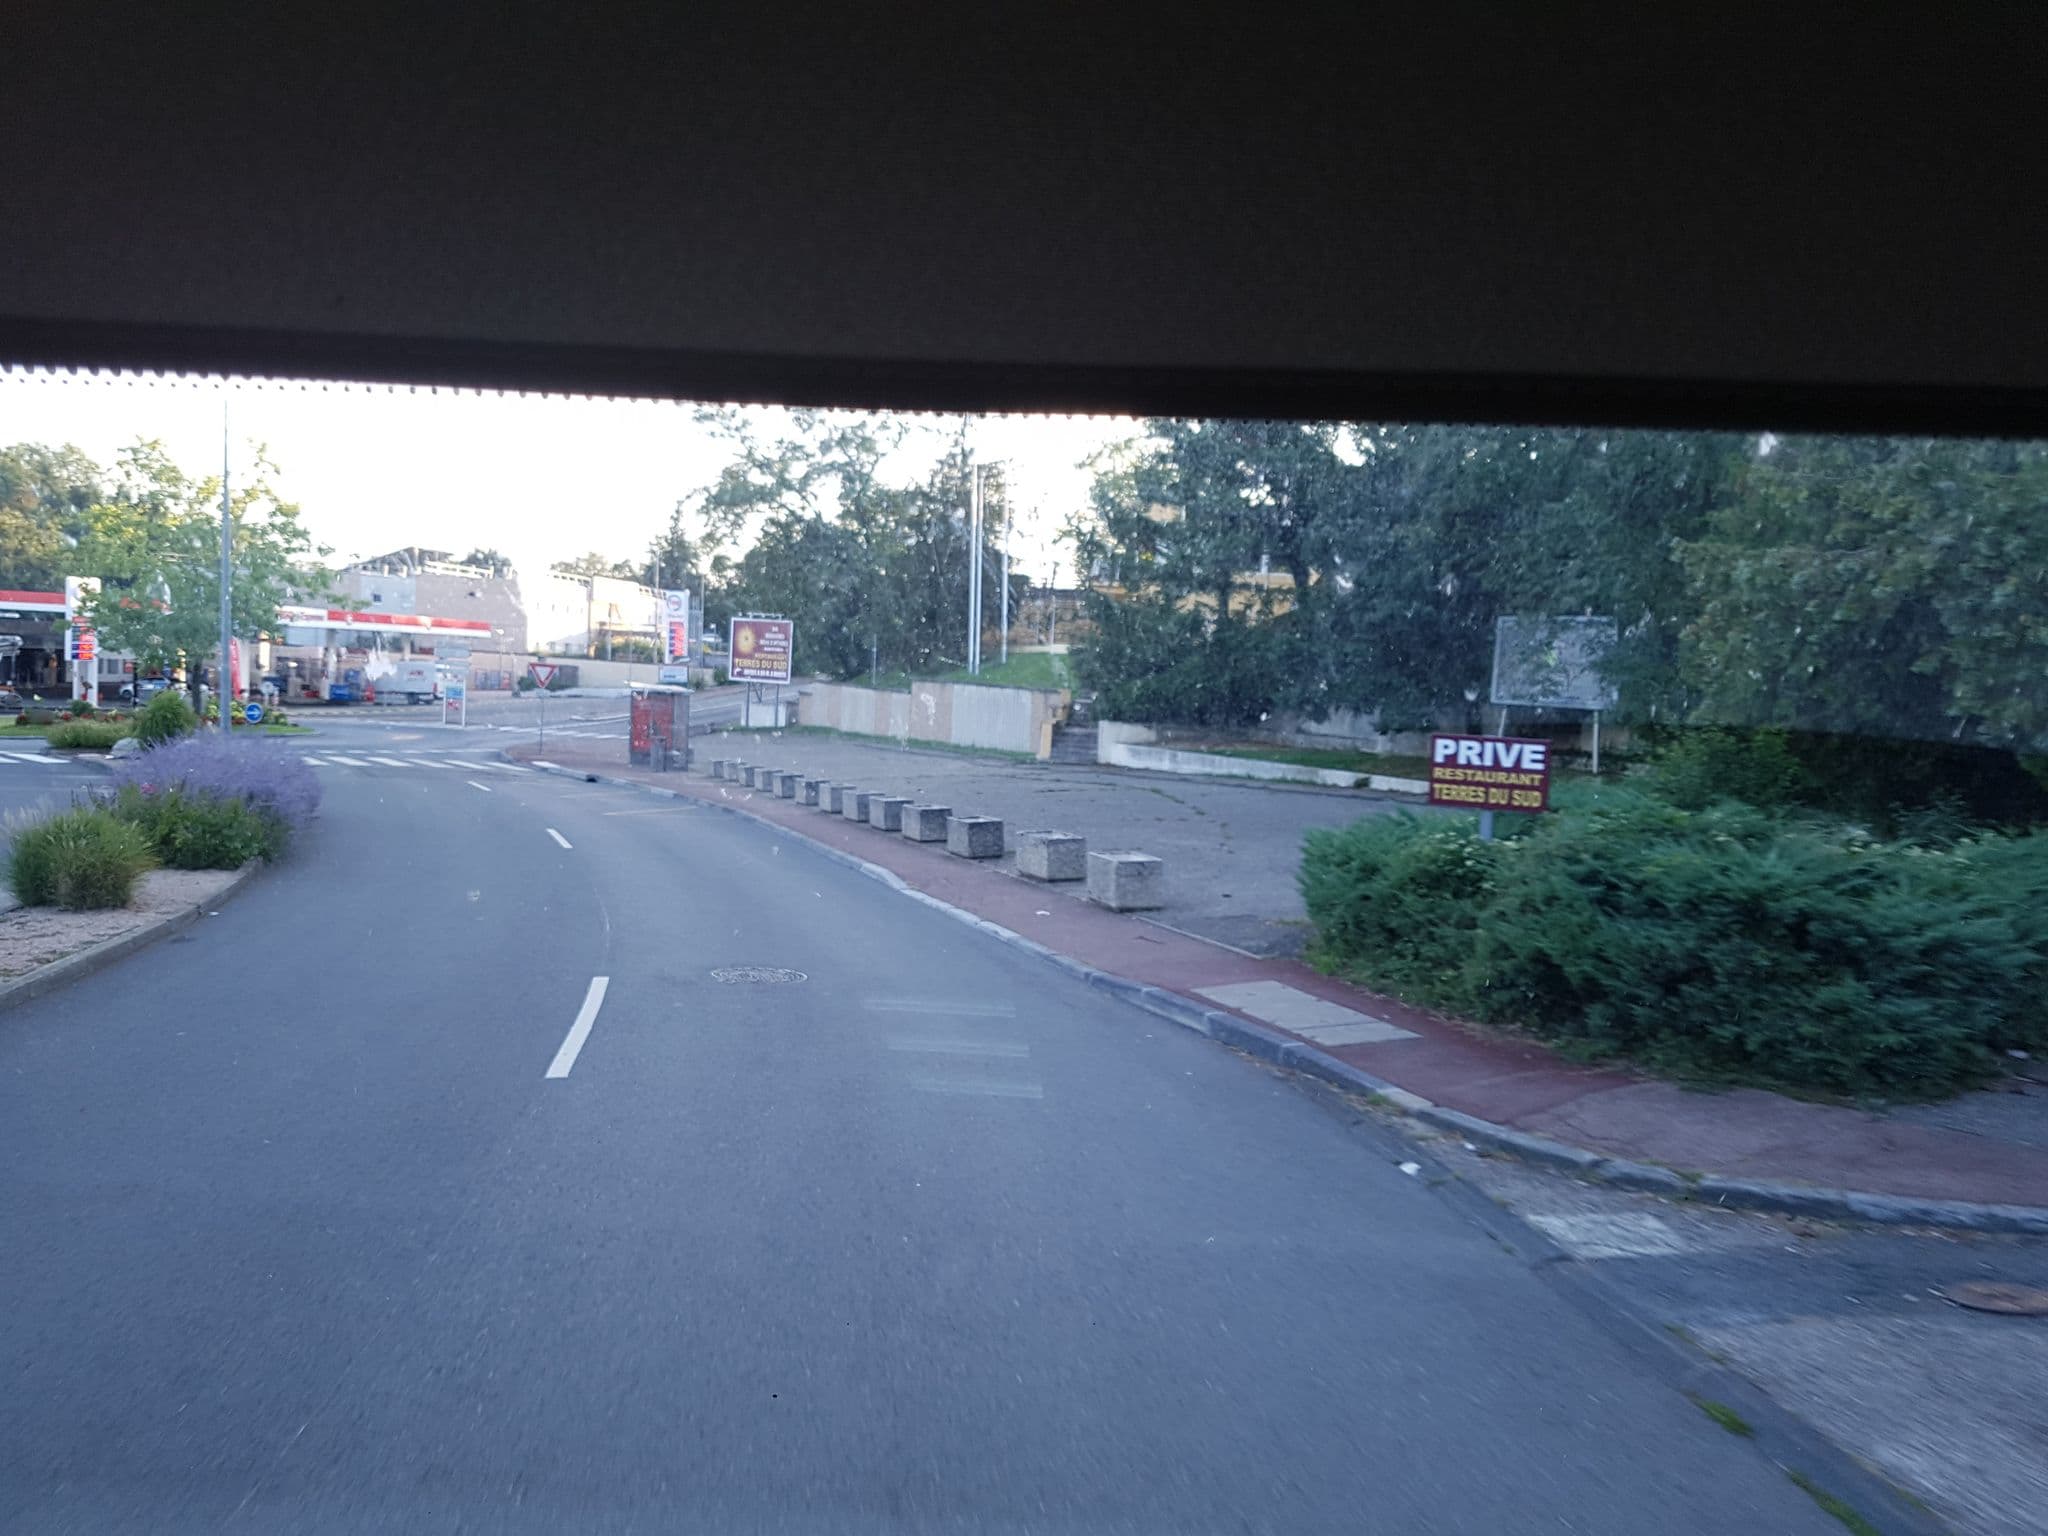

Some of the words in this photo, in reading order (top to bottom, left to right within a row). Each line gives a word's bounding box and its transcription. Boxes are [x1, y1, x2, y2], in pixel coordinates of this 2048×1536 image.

[1433, 738, 1546, 770] PRIVE
[1432, 767, 1544, 785] RESTAURANT
[1432, 783, 1486, 803] TERRES
[1488, 788, 1509, 805] DU
[1511, 790, 1542, 808] SUD
